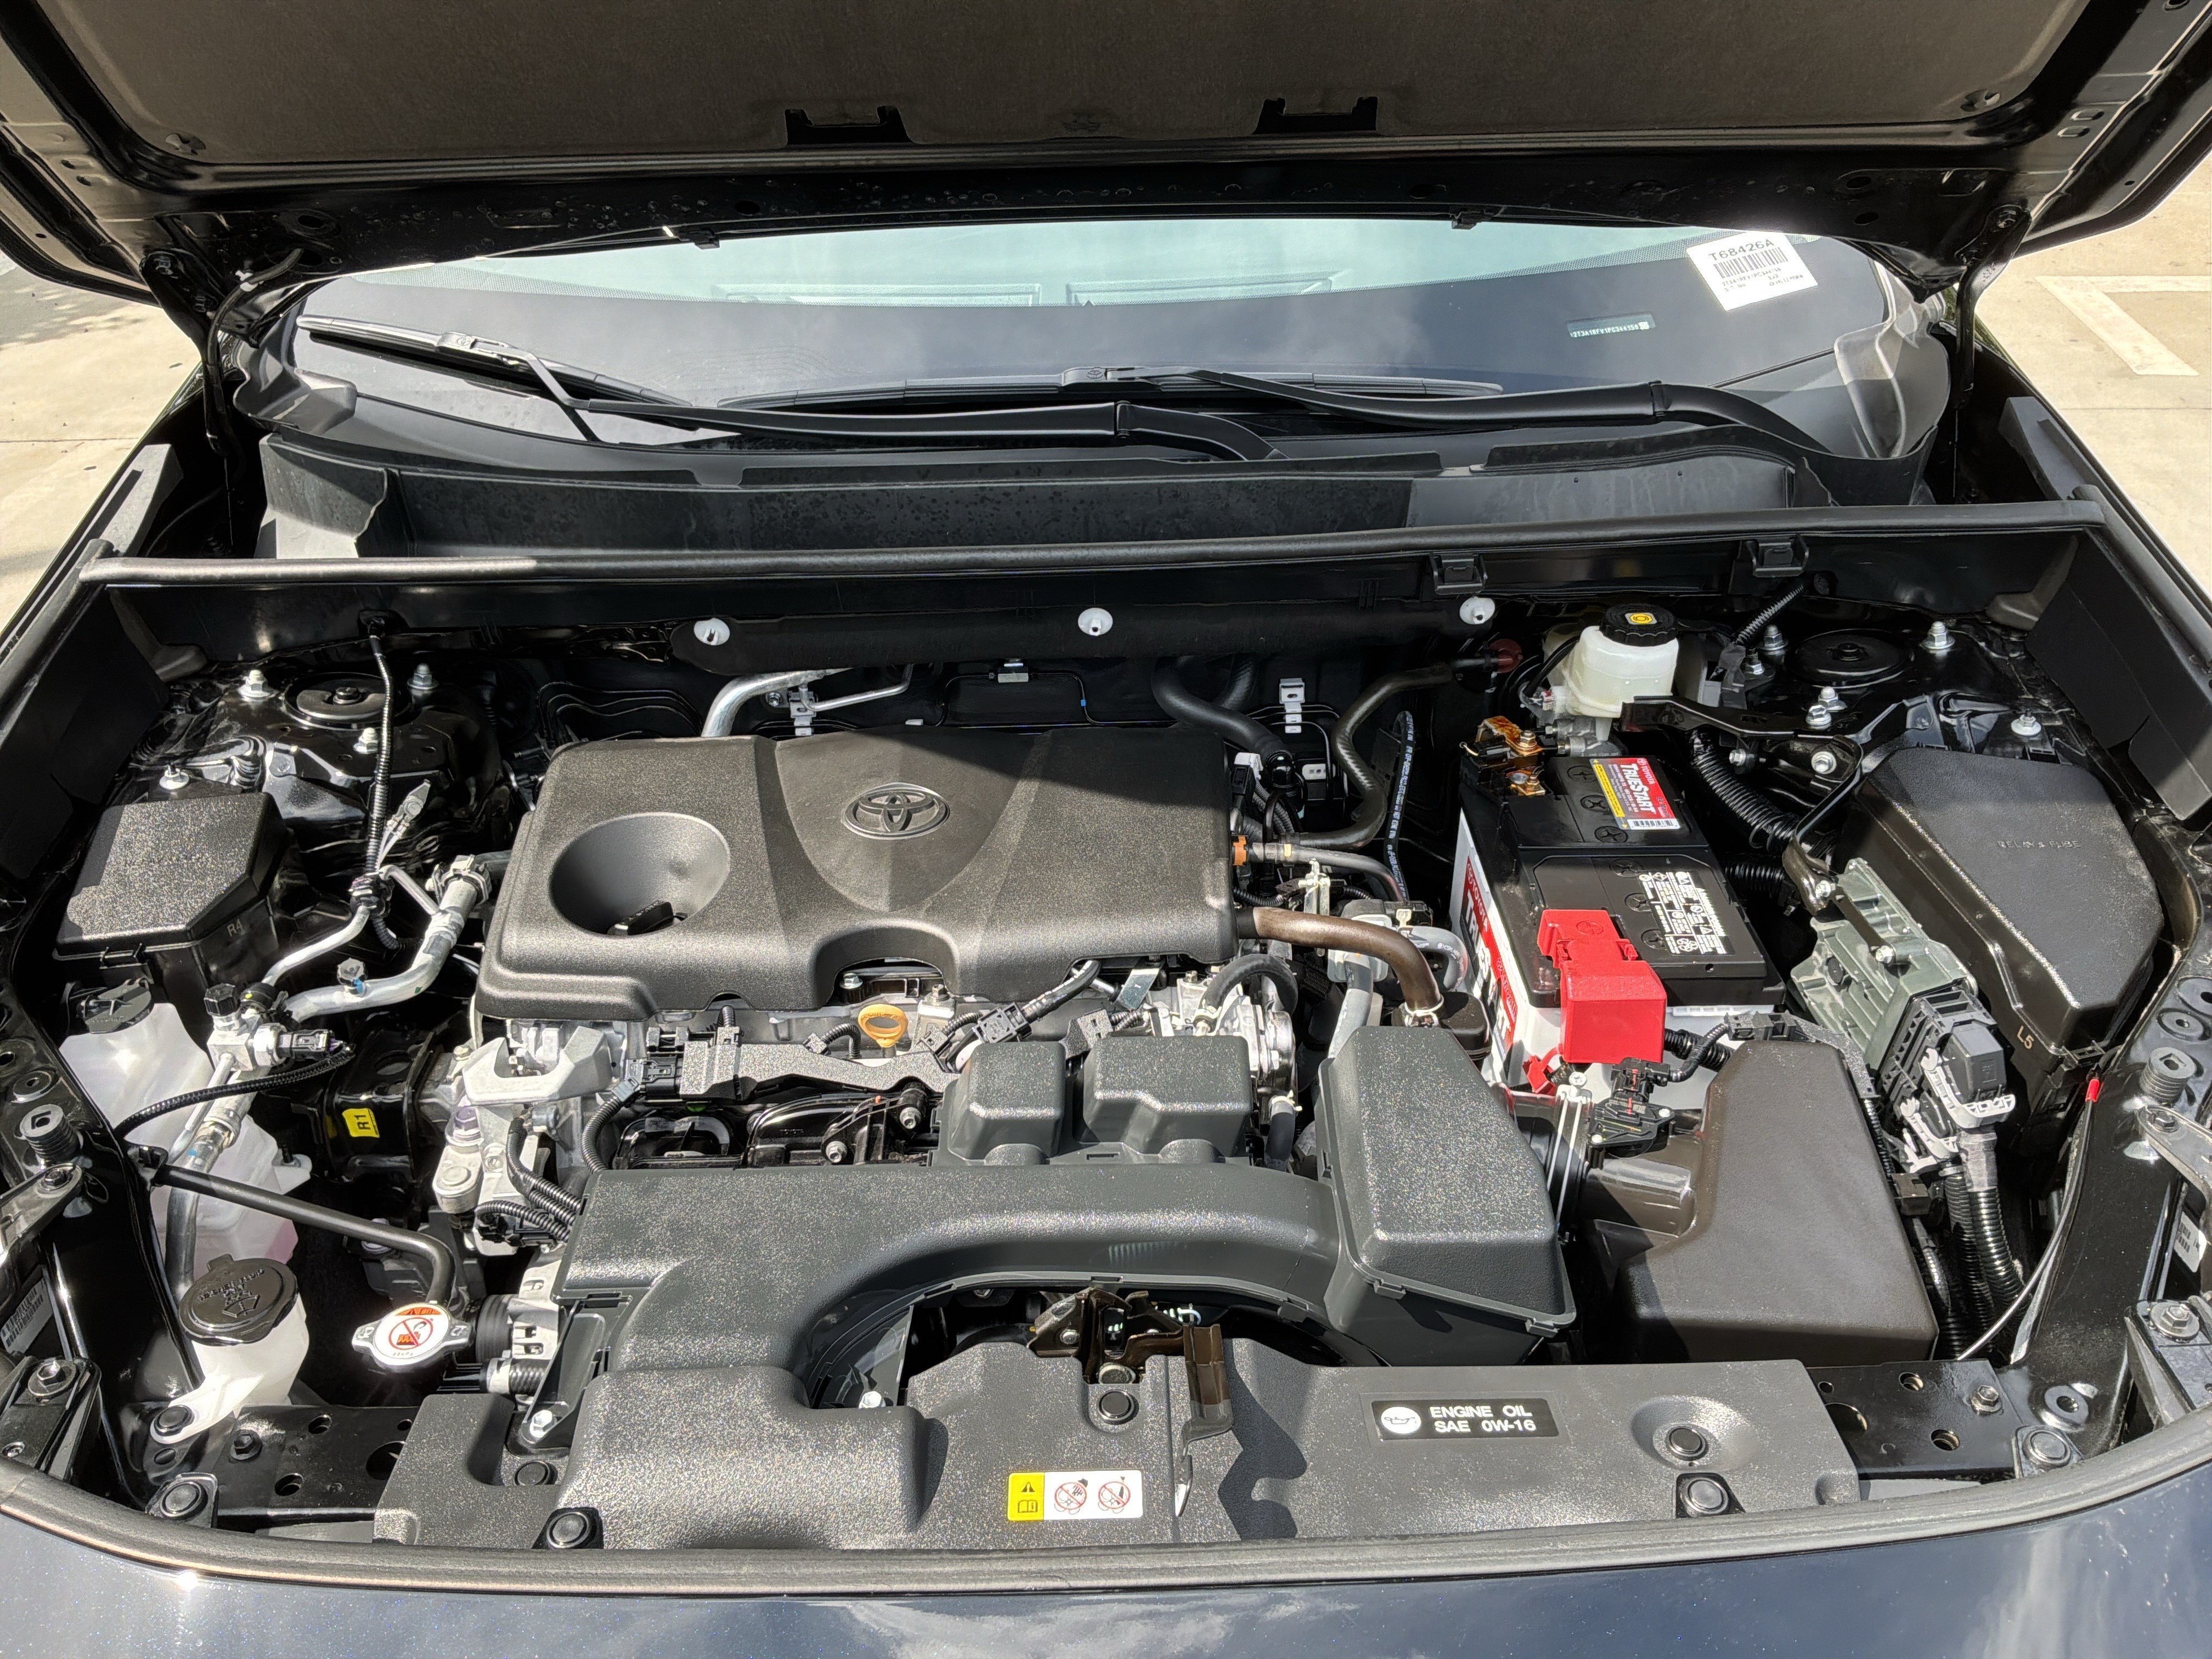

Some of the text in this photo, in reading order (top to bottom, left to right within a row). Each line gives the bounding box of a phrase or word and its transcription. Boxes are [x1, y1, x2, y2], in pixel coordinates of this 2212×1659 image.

[1708, 239, 1774, 261] T68426A
[1640, 765, 1656, 784] TOYOTA
[2049, 840, 2081, 849] FUSE
[1472, 878, 1488, 933] TOYOTA
[227, 918, 243, 937] R4
[2017, 1025, 2035, 1049] L5
[354, 1115, 371, 1130] R1
[1429, 1405, 1533, 1418] ENGINE OIL
[1434, 1419, 1537, 1432] SAE 0W-16
